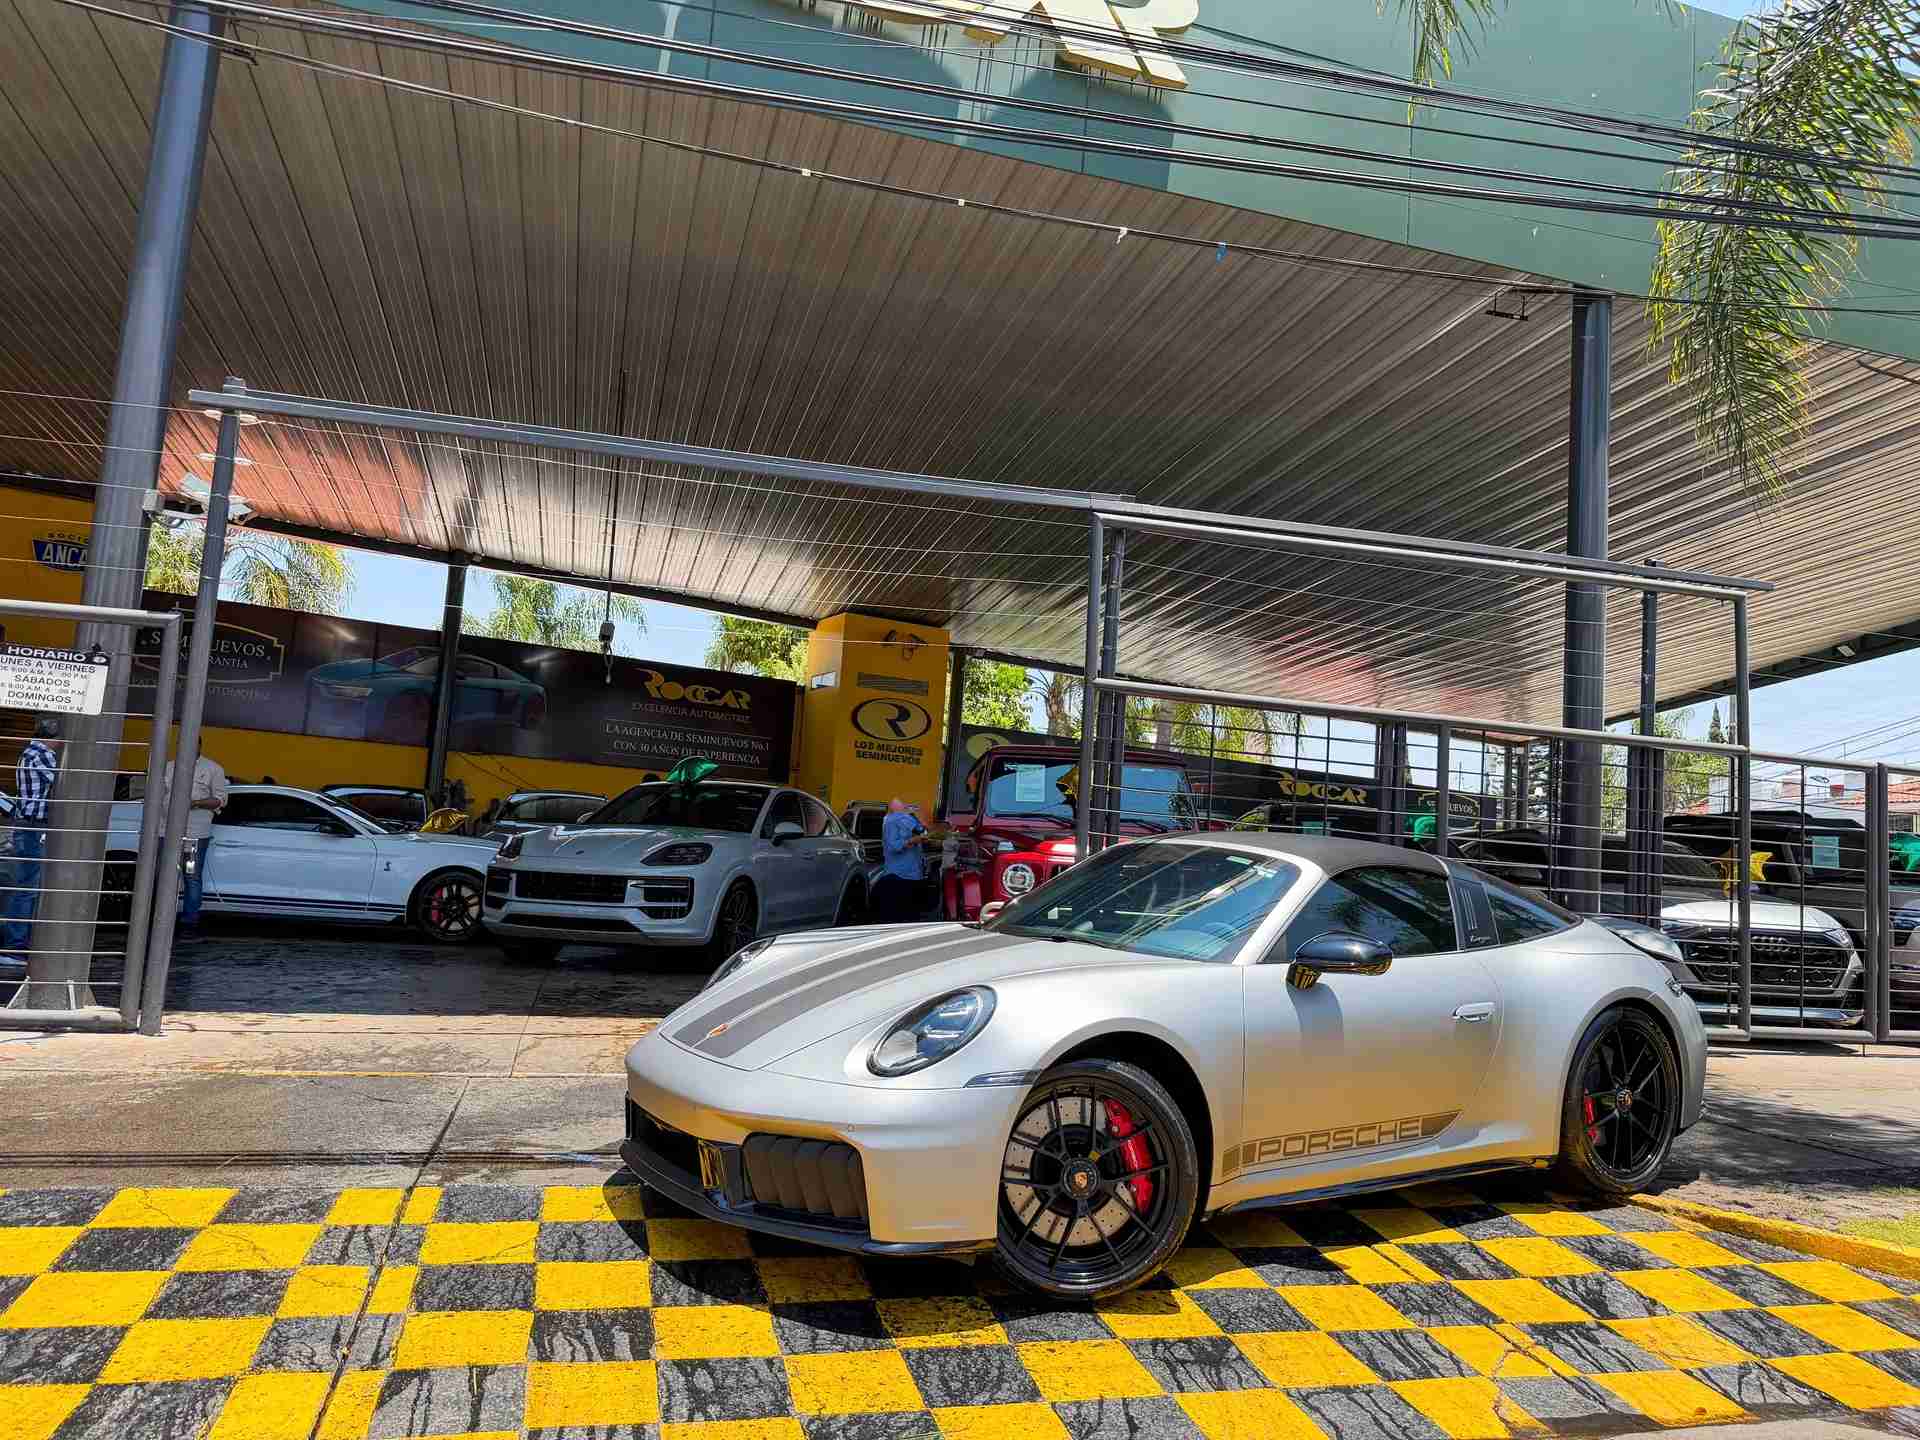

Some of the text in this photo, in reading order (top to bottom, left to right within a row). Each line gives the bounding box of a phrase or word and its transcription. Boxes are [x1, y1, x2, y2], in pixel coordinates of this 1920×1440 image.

[8, 646, 86, 662] HORARIO
[0, 656, 96, 674] UNES A VIERNES
[8, 690, 72, 704] DOMINGOS
[633, 667, 752, 710] ROCCAR
[622, 726, 668, 740] AGENCIA
[686, 732, 749, 749] SEMINUEVOS
[1257, 1116, 1421, 1162] PORSCHE
